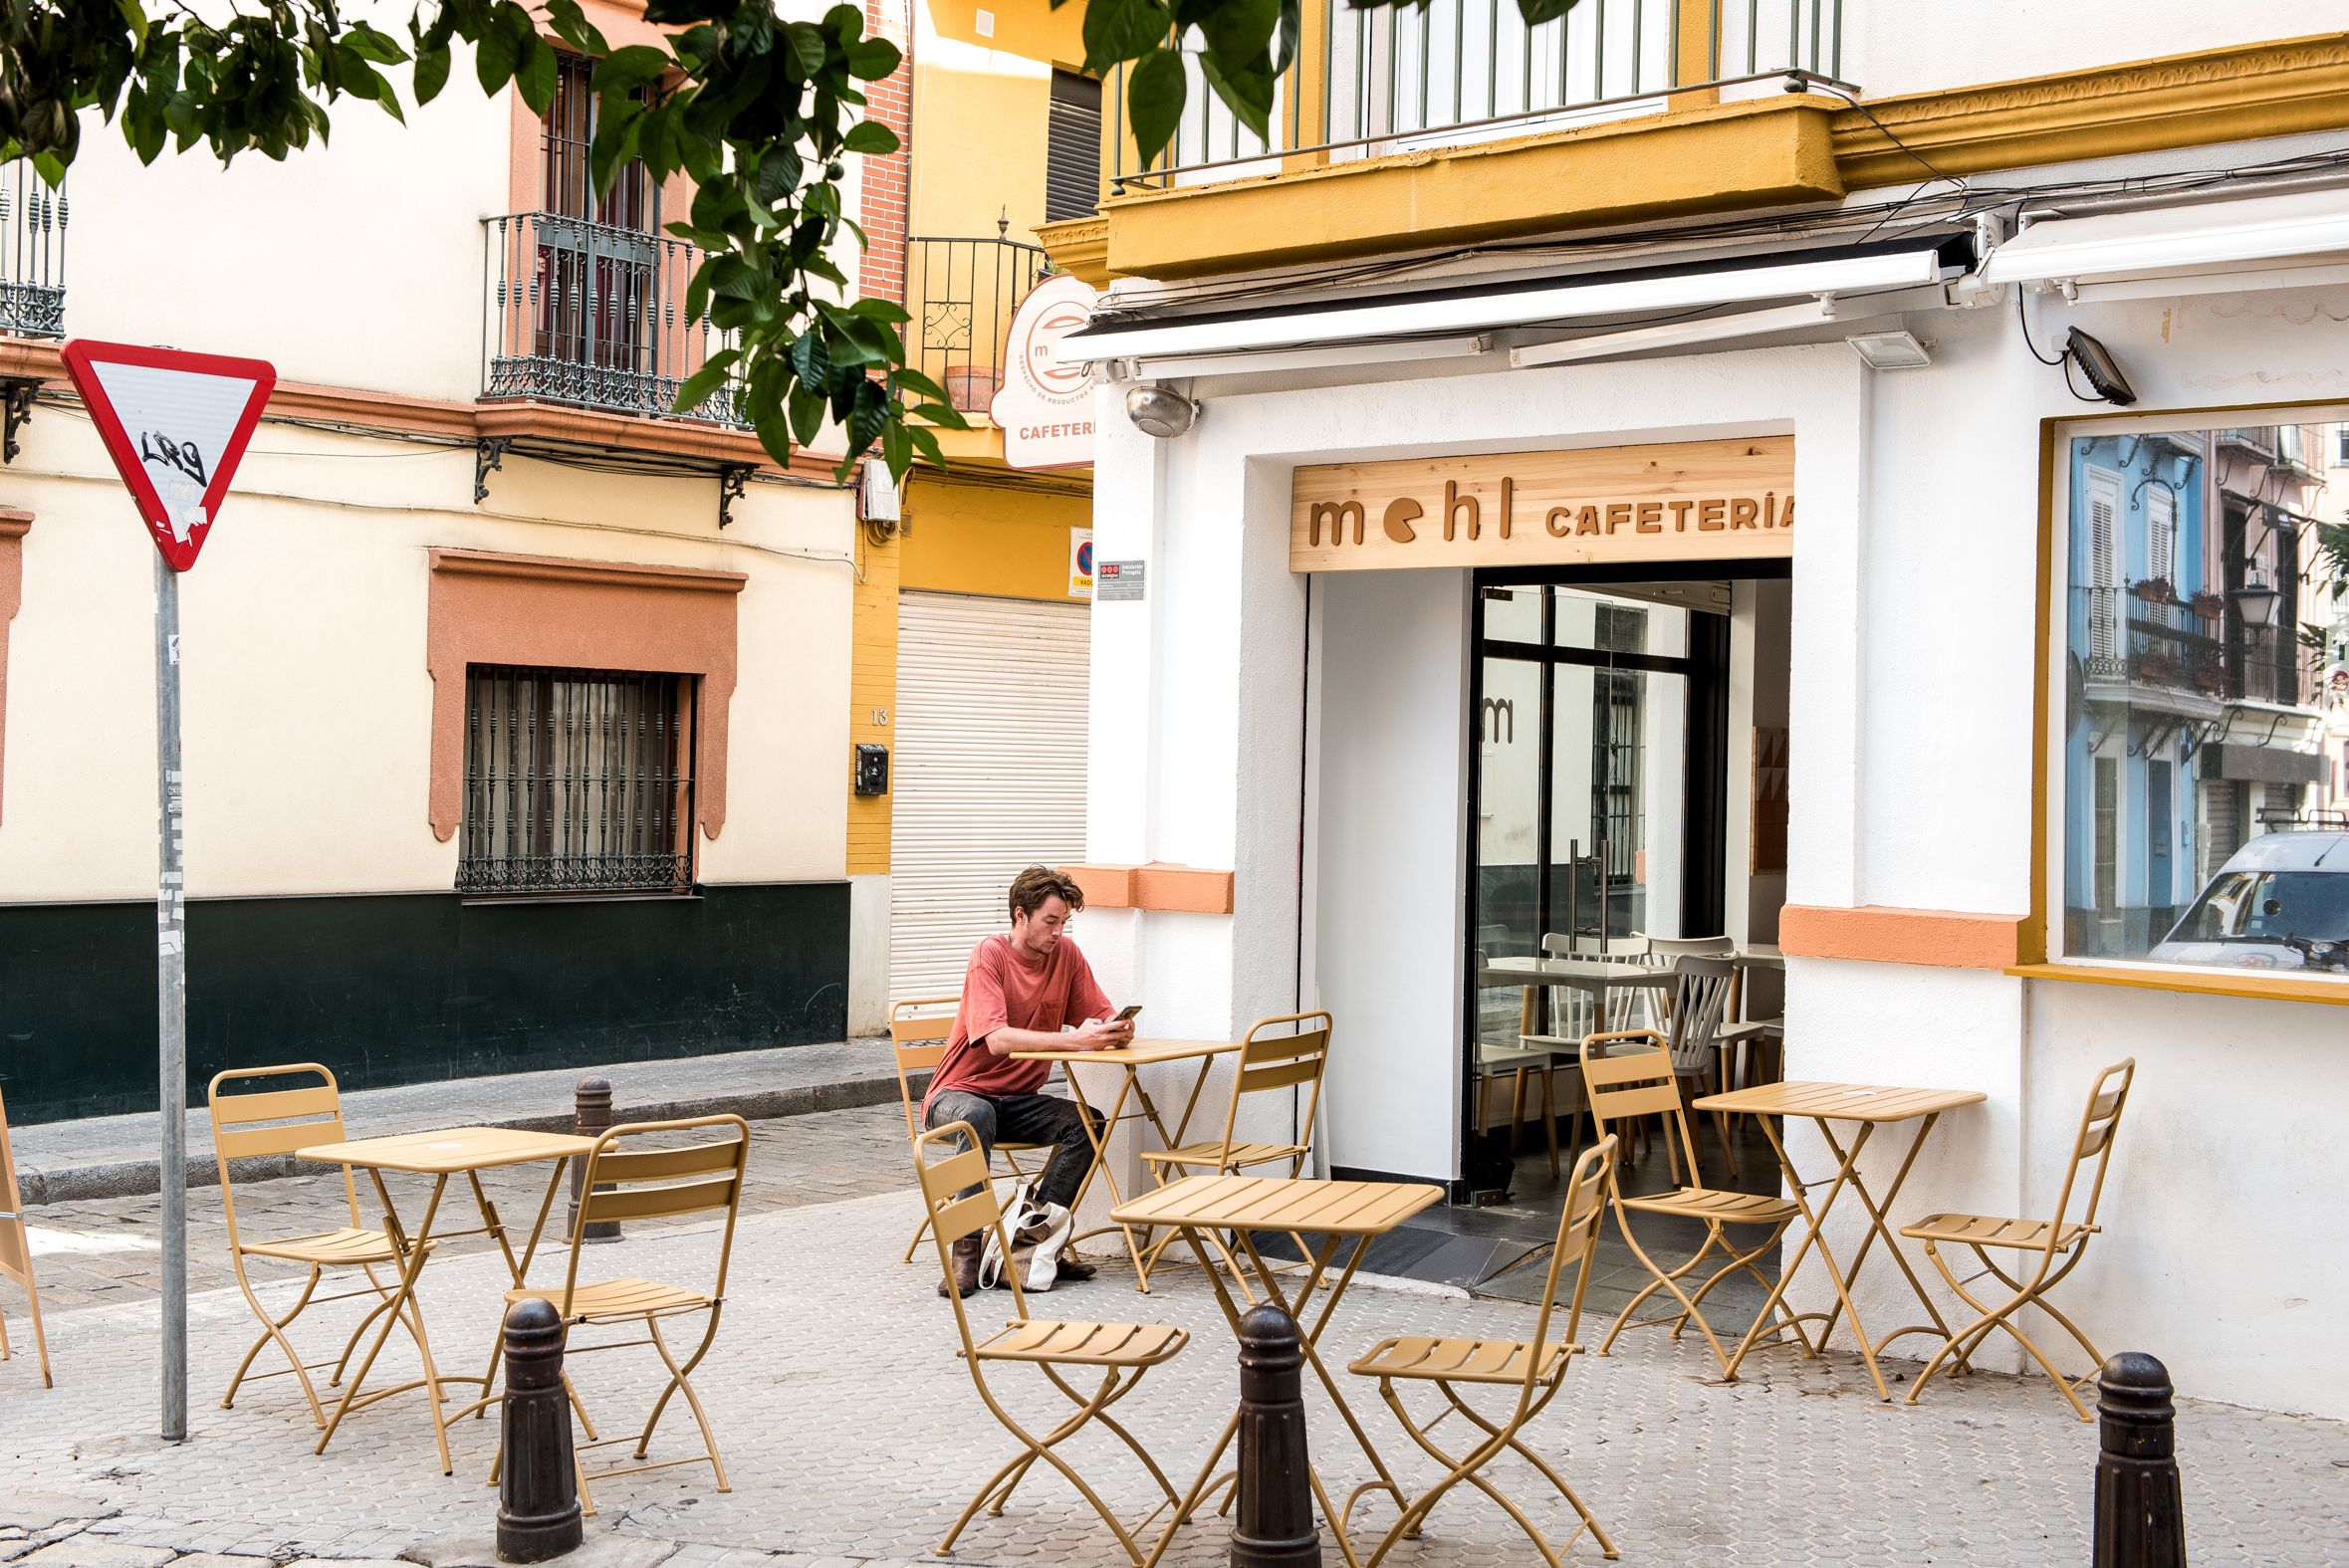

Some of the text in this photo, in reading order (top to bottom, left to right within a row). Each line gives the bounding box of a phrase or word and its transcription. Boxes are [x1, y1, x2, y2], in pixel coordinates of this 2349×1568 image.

[1019, 354, 1088, 405] DESPACHO DE PRODUCTOS
[1308, 477, 1513, 547] mehl
[871, 708, 888, 726] 13
